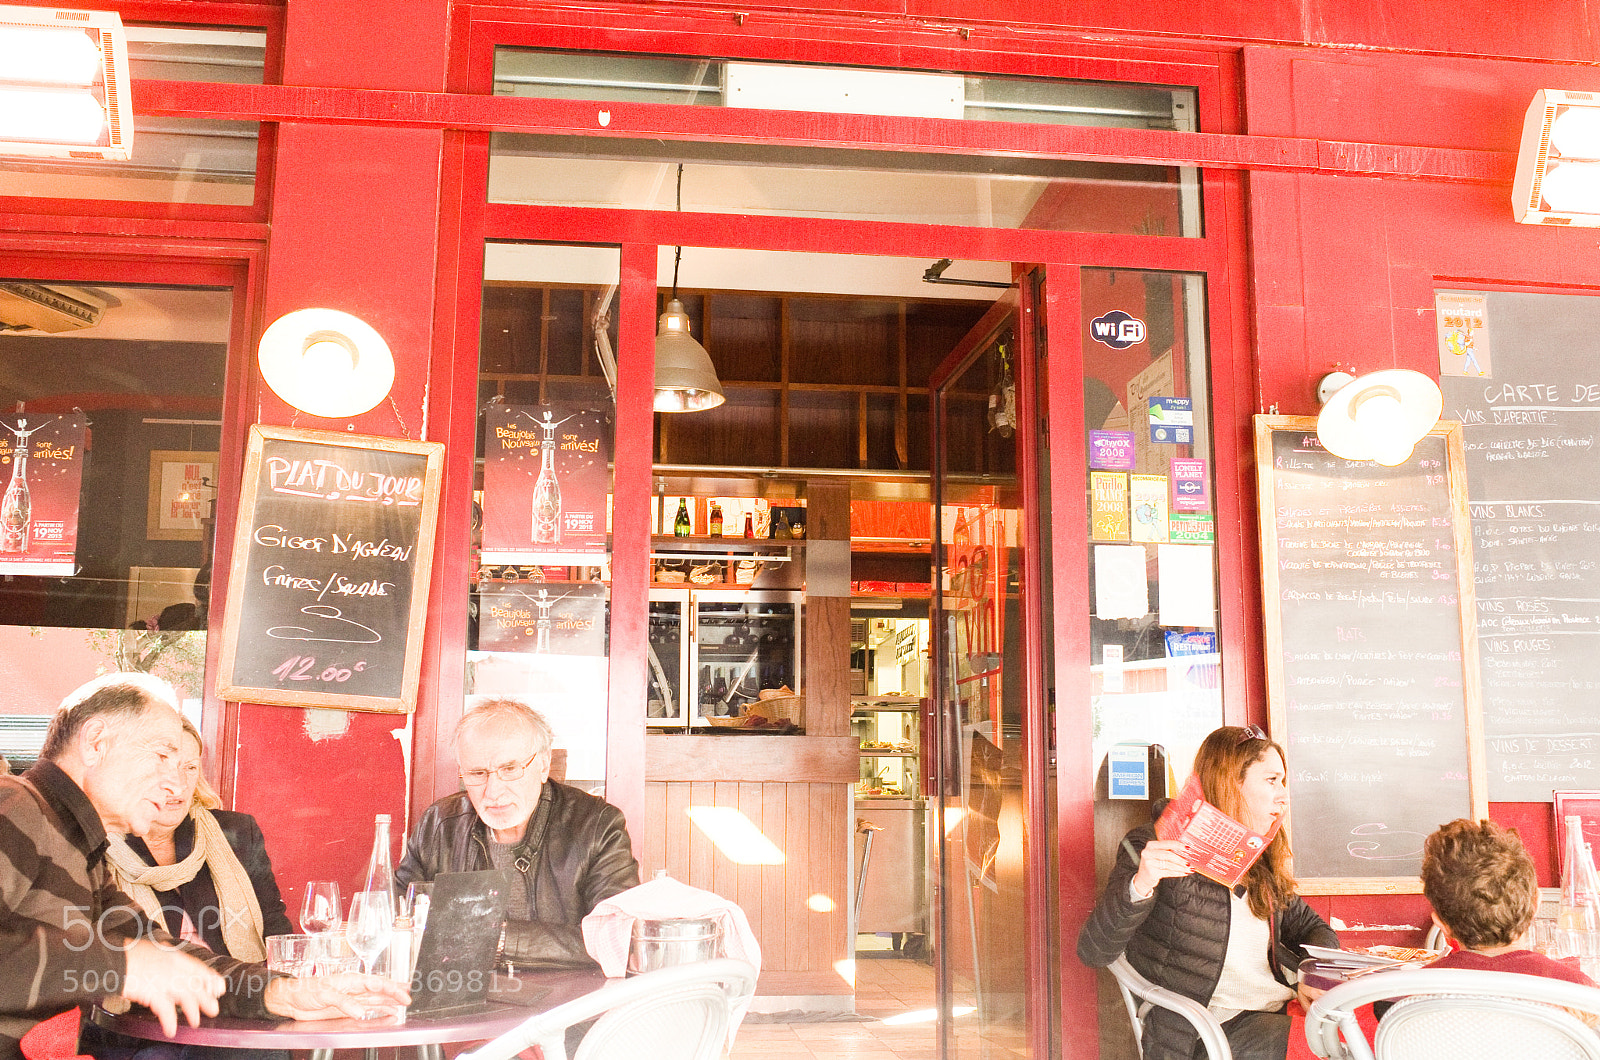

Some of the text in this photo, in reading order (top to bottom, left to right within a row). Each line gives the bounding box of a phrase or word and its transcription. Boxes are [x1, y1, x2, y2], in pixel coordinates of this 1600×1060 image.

[1441, 307, 1483, 317] routard
[1484, 383, 1600, 404] CARTE DE
[1455, 406, 1486, 424] VINS
[495, 427, 536, 441] Beaujolais
[33, 446, 75, 460] arrivés!
[560, 439, 600, 453] arrivés!
[1099, 448, 1125, 458] 2008
[266, 456, 422, 500] PLAT DU JOUR
[1095, 488, 1125, 502] FRANCE
[1096, 501, 1124, 513] 2008
[1469, 504, 1496, 519] VINS
[564, 519, 578, 530] 19
[33, 528, 47, 538] 19
[1175, 531, 1209, 540] 2004
[490, 606, 531, 619] Beaujolais
[1477, 600, 1505, 613] VINS
[1481, 618, 1499, 628] AOC
[1485, 638, 1509, 653] VINS
[1491, 739, 1520, 753] VINS
